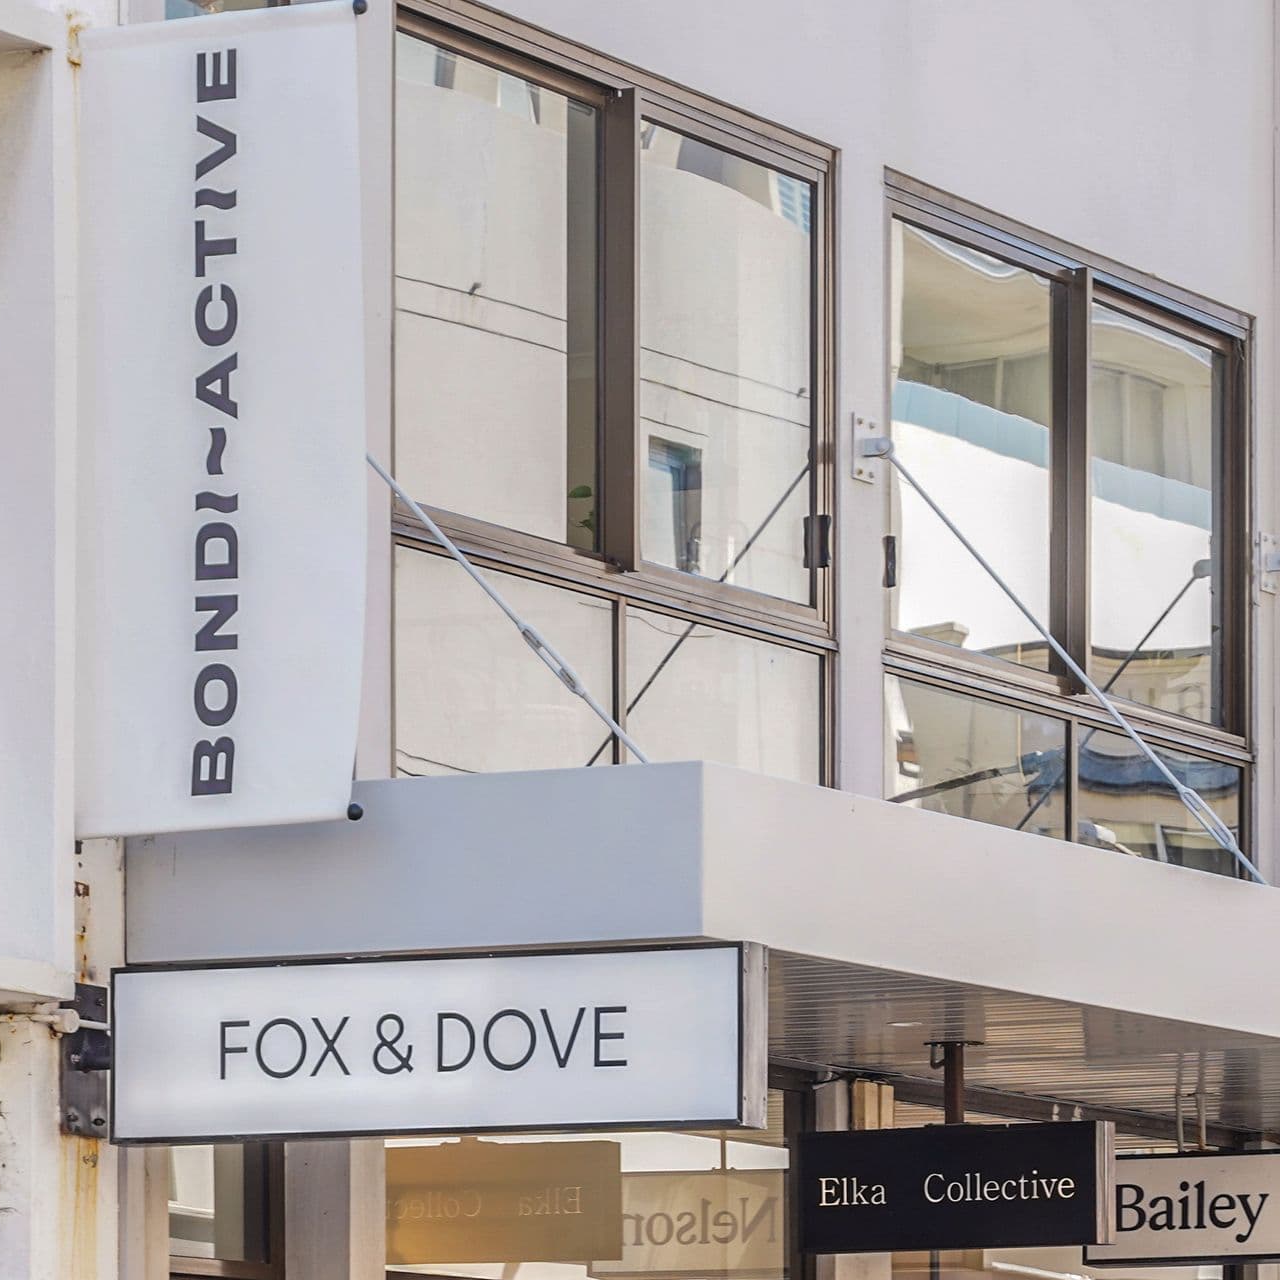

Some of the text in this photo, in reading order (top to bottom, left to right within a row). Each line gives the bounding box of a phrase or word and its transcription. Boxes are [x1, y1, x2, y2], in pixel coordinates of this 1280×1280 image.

[219, 1005, 628, 1081] FOX & DOVE
[818, 1169, 1076, 1207] Elka Collective
[1115, 1180, 1269, 1243] Bailey
